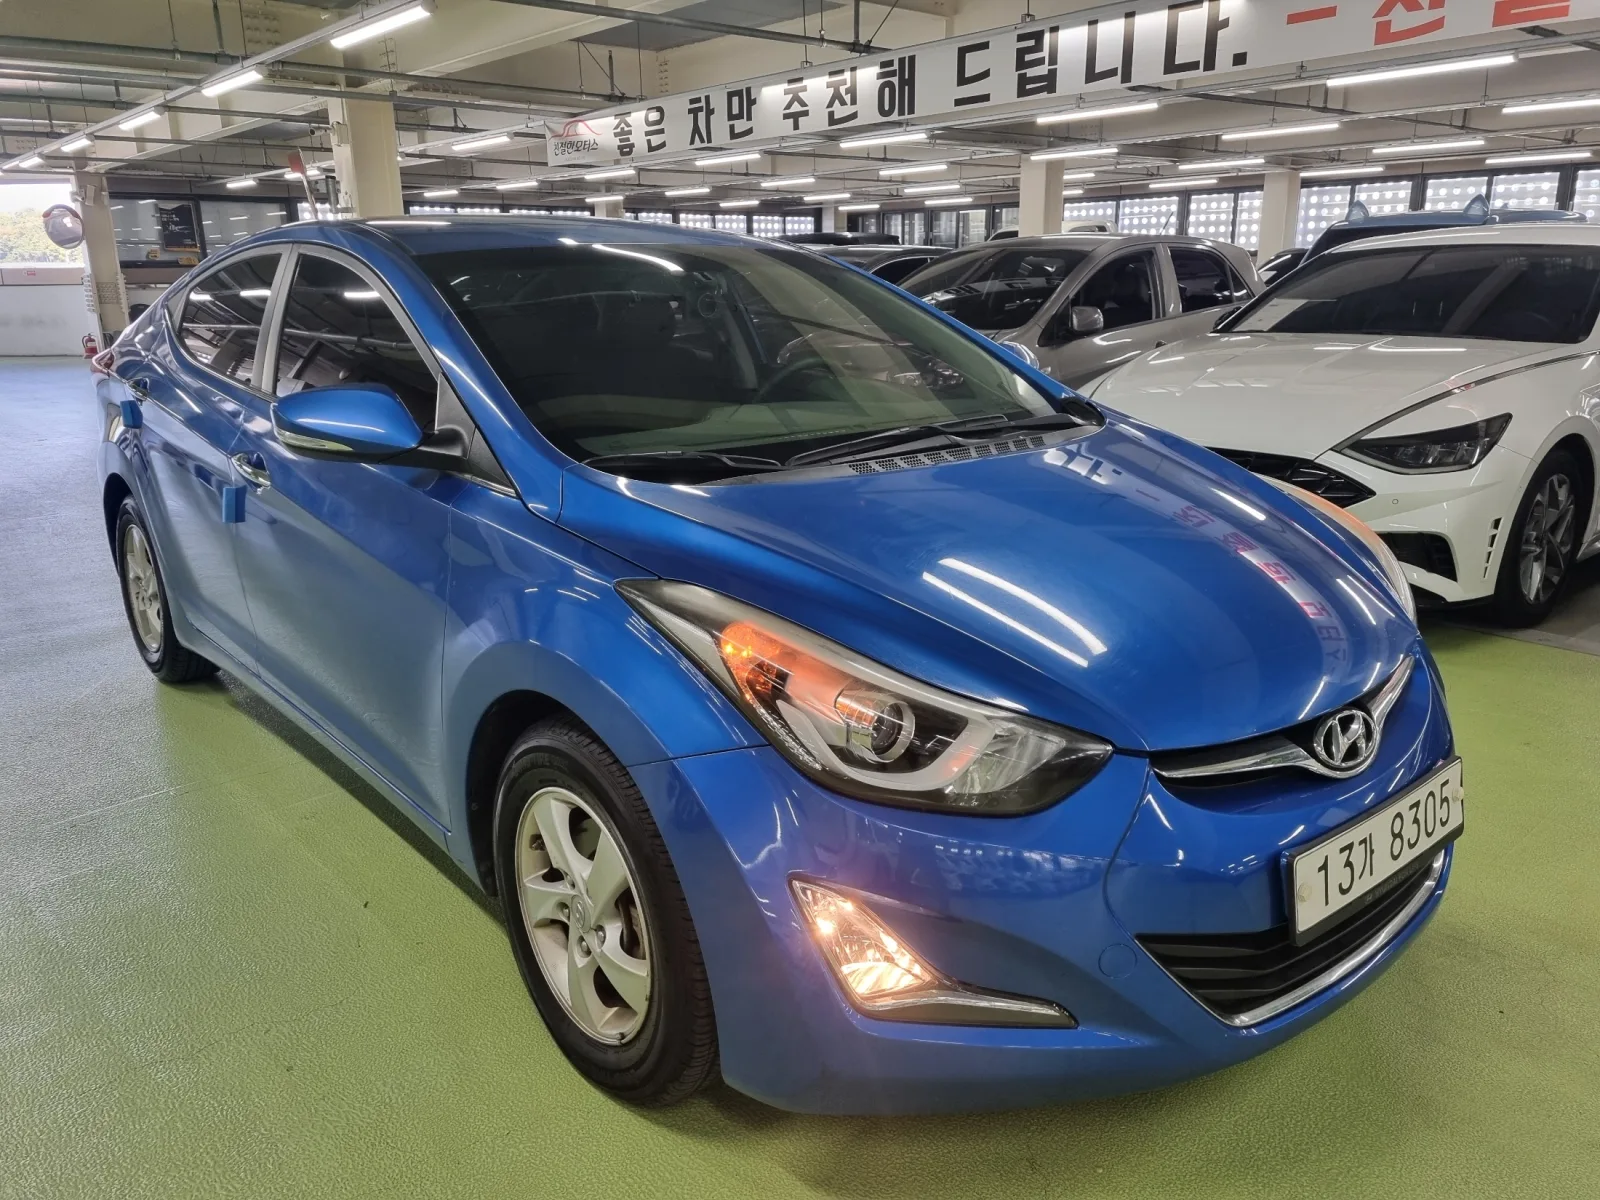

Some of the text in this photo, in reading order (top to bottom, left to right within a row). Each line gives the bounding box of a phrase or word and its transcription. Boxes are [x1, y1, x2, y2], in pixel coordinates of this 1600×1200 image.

[613, 106, 667, 157] 좋은
[687, 86, 757, 147] 차만
[782, 54, 916, 127] 추천해
[954, 0, 1248, 107] 드립니다.
[1318, 832, 1375, 907] 13가
[1390, 778, 1450, 862] 8305
